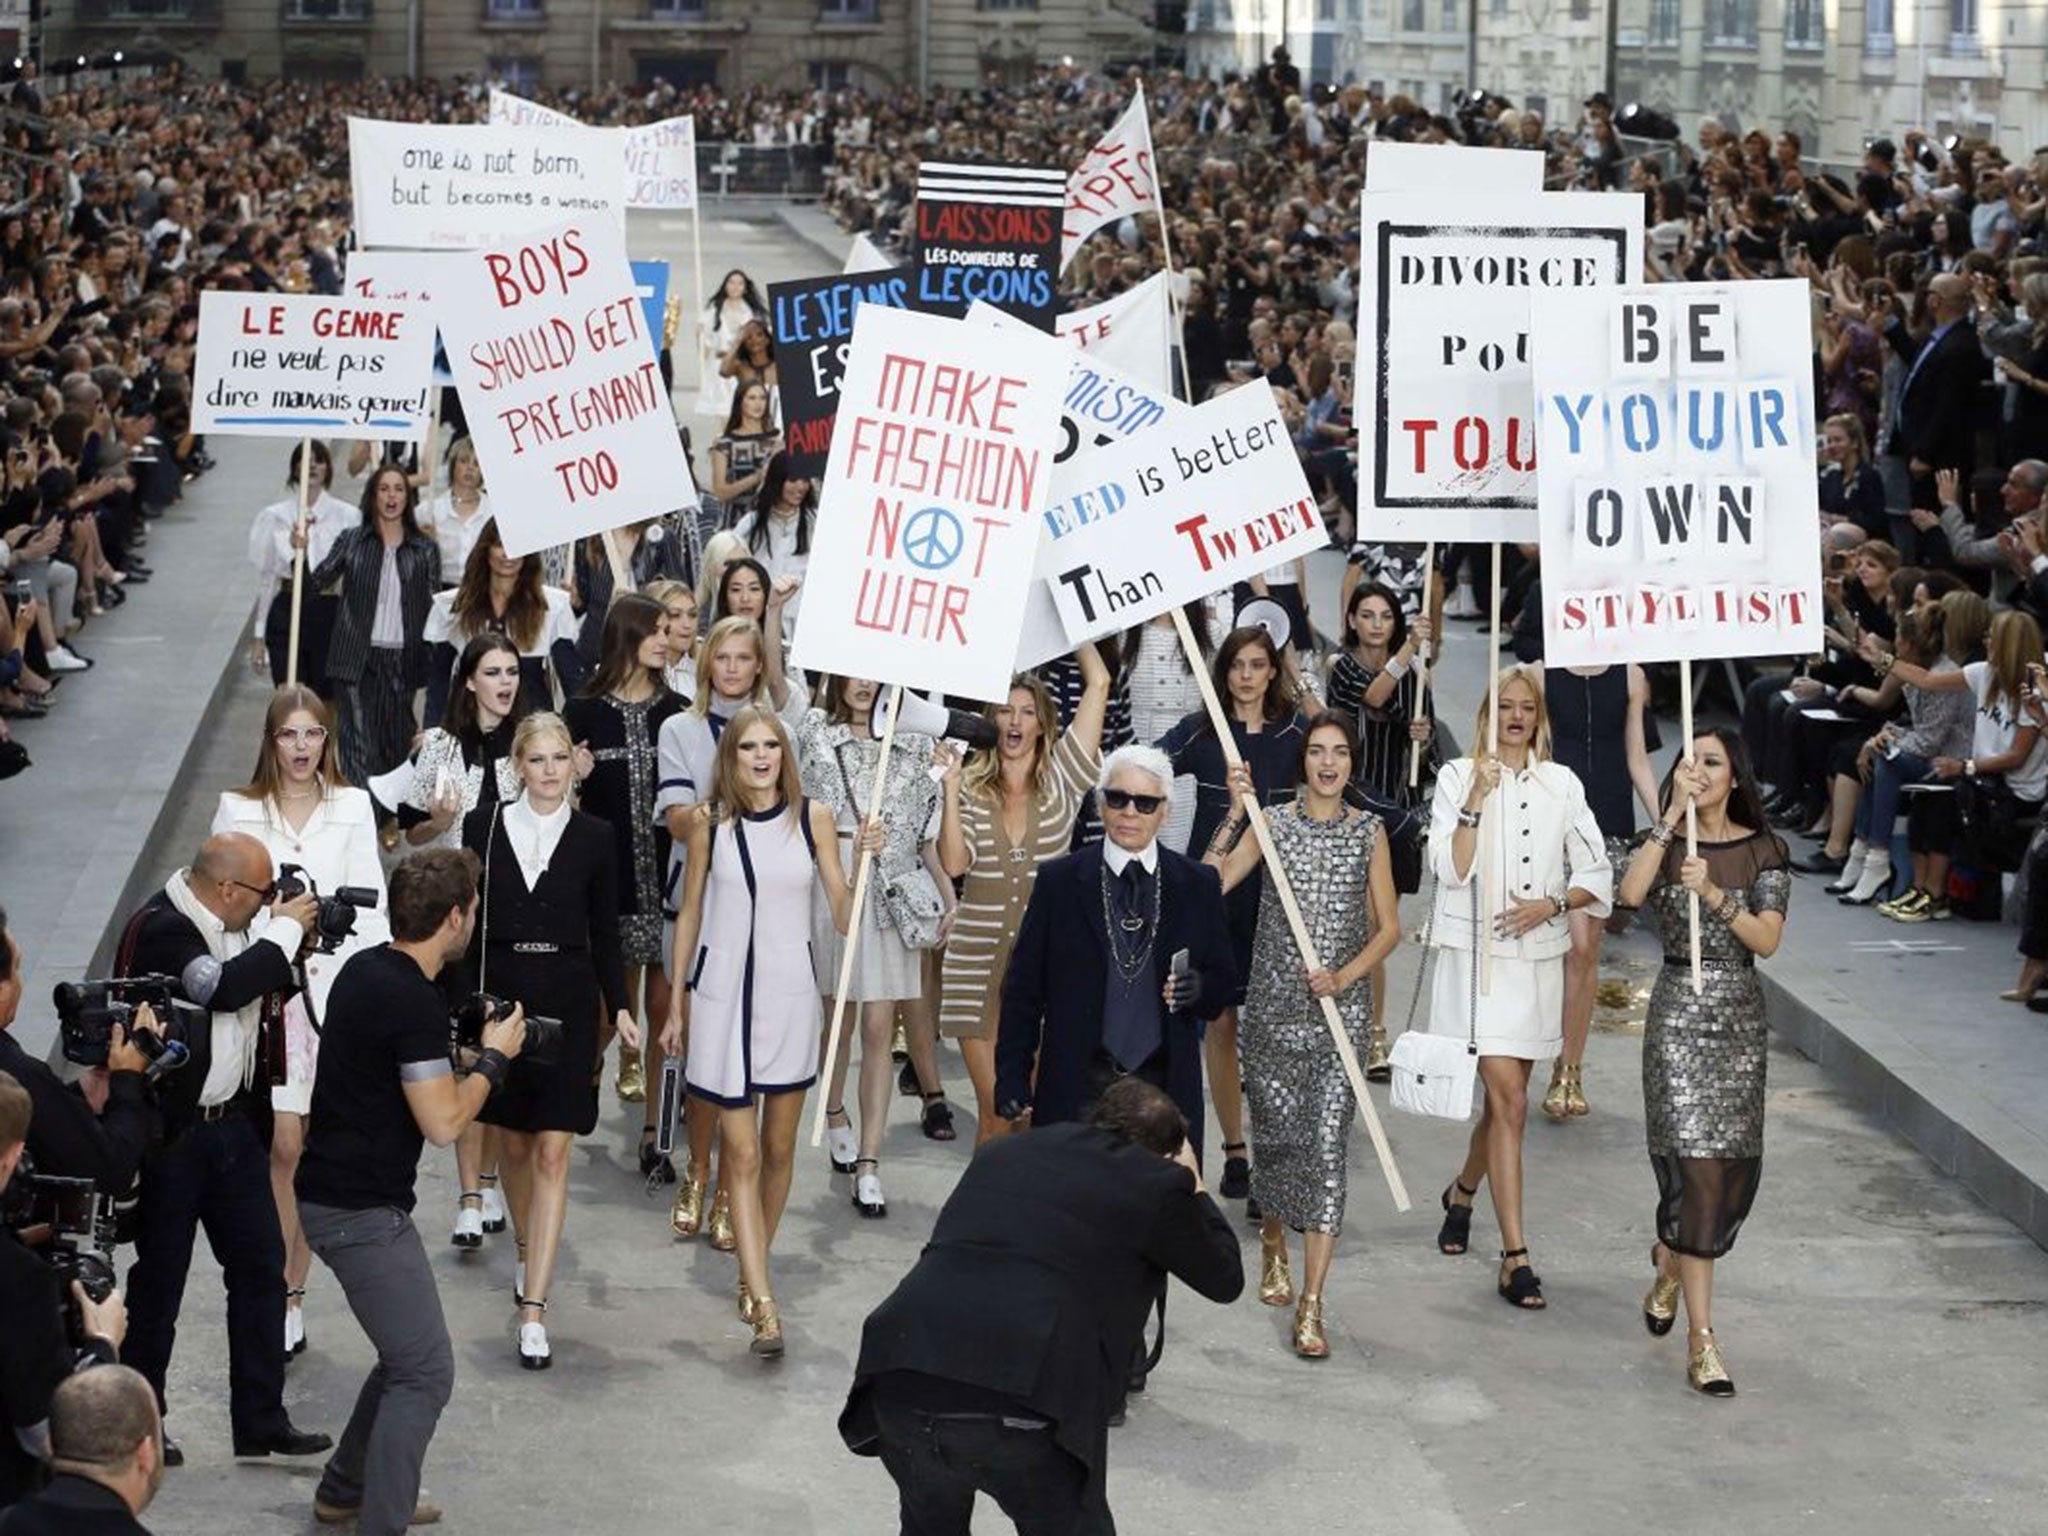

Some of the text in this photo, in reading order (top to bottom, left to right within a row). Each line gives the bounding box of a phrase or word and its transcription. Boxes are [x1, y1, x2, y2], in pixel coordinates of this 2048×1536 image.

[404, 147, 584, 179] one is not born,
[392, 176, 608, 211] but becomes a woman
[918, 203, 1055, 244] LAISSONS
[484, 230, 589, 309] BOYS
[924, 248, 1039, 269] LES DONNEURS DE
[1400, 255, 1598, 288] DIVORCE
[919, 267, 1052, 309] LEÇONS
[243, 306, 405, 340] LE GENRE
[470, 297, 638, 391] SHOULD GET
[777, 293, 812, 343] LE
[1622, 303, 1726, 364] BE
[232, 347, 386, 381] ne veut pas
[206, 378, 427, 426] dire mauvais genre!
[498, 363, 658, 455] PREGNANT
[877, 354, 1028, 435] MAKE
[1403, 416, 1537, 473] TOU
[1553, 388, 1790, 456] YOUR
[555, 451, 618, 503] TOO
[846, 416, 1040, 513] FASHION
[1043, 481, 1128, 542] EED
[1136, 466, 1166, 497] is
[1171, 418, 1278, 481] better
[1586, 483, 1754, 548] OWN
[854, 568, 968, 646] WAR
[1059, 563, 1164, 623] Than
[1561, 590, 1808, 631] STYLIST
